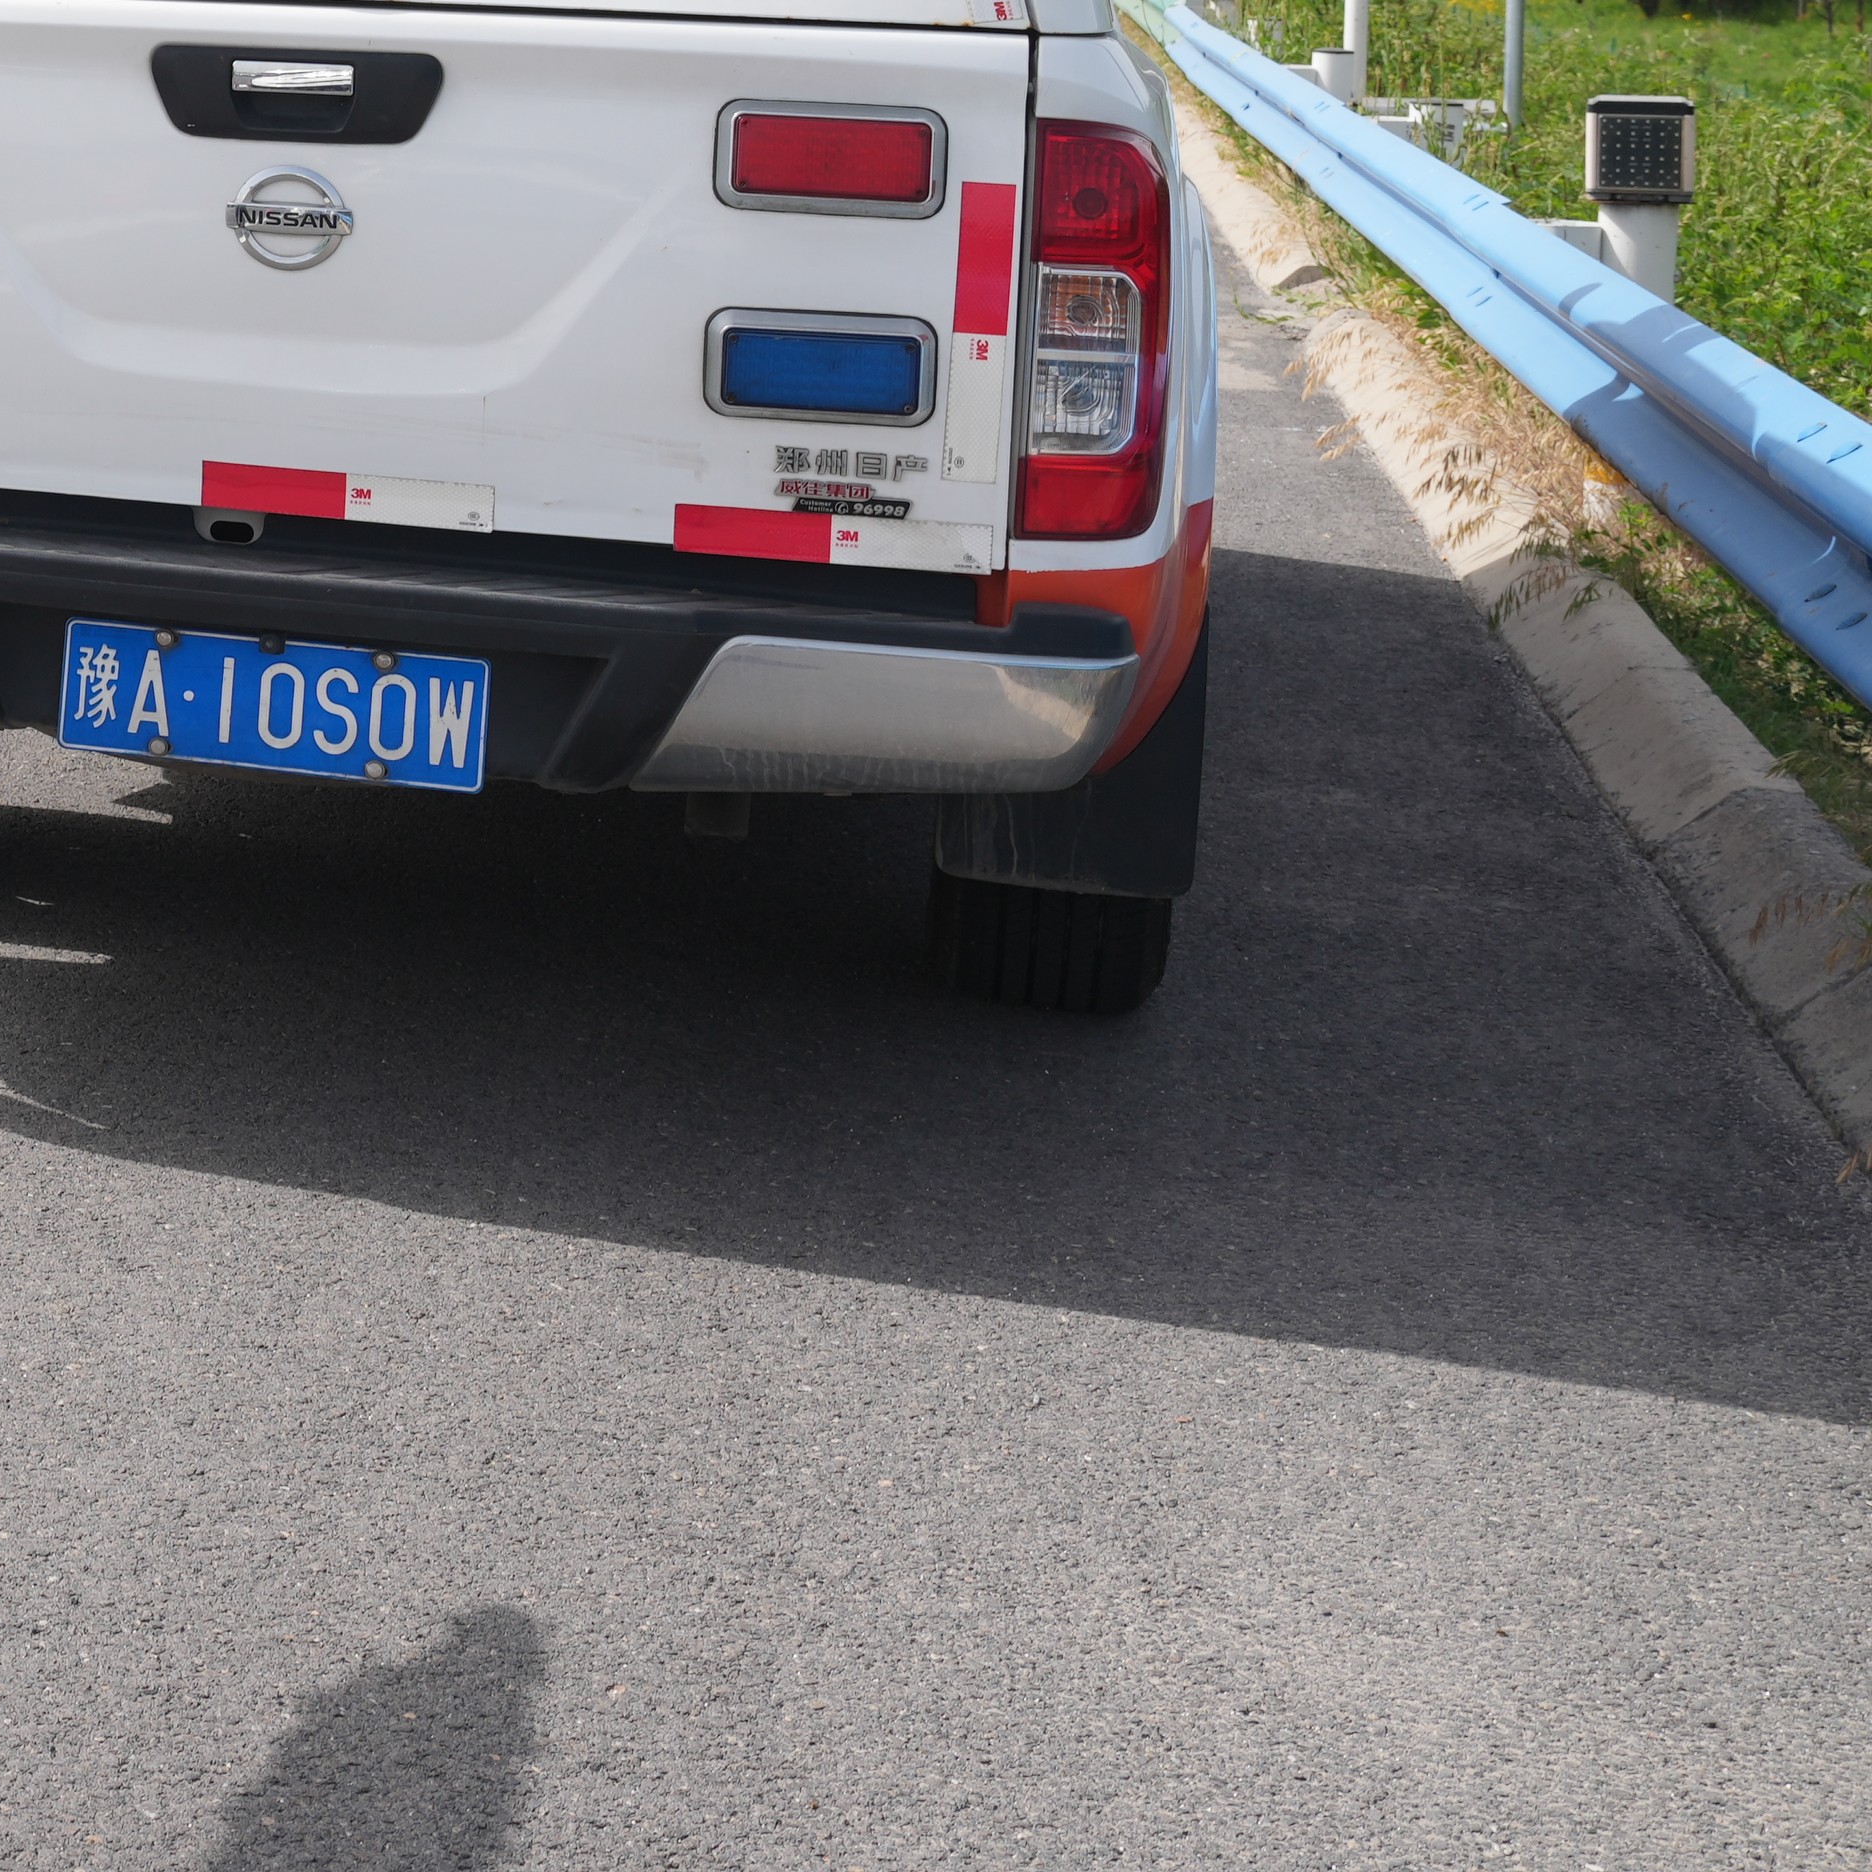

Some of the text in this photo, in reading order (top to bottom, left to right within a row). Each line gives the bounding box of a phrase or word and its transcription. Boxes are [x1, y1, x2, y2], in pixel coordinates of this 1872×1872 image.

[993, 1, 1007, 21] 3M
[239, 208, 337, 229] NISSAN
[976, 339, 989, 361] 3M
[774, 445, 928, 482] 郑州日产
[351, 488, 371, 500] 3M
[799, 498, 906, 517] Customer 96998
[808, 505, 834, 513] Hotline
[836, 530, 859, 542] 3M
